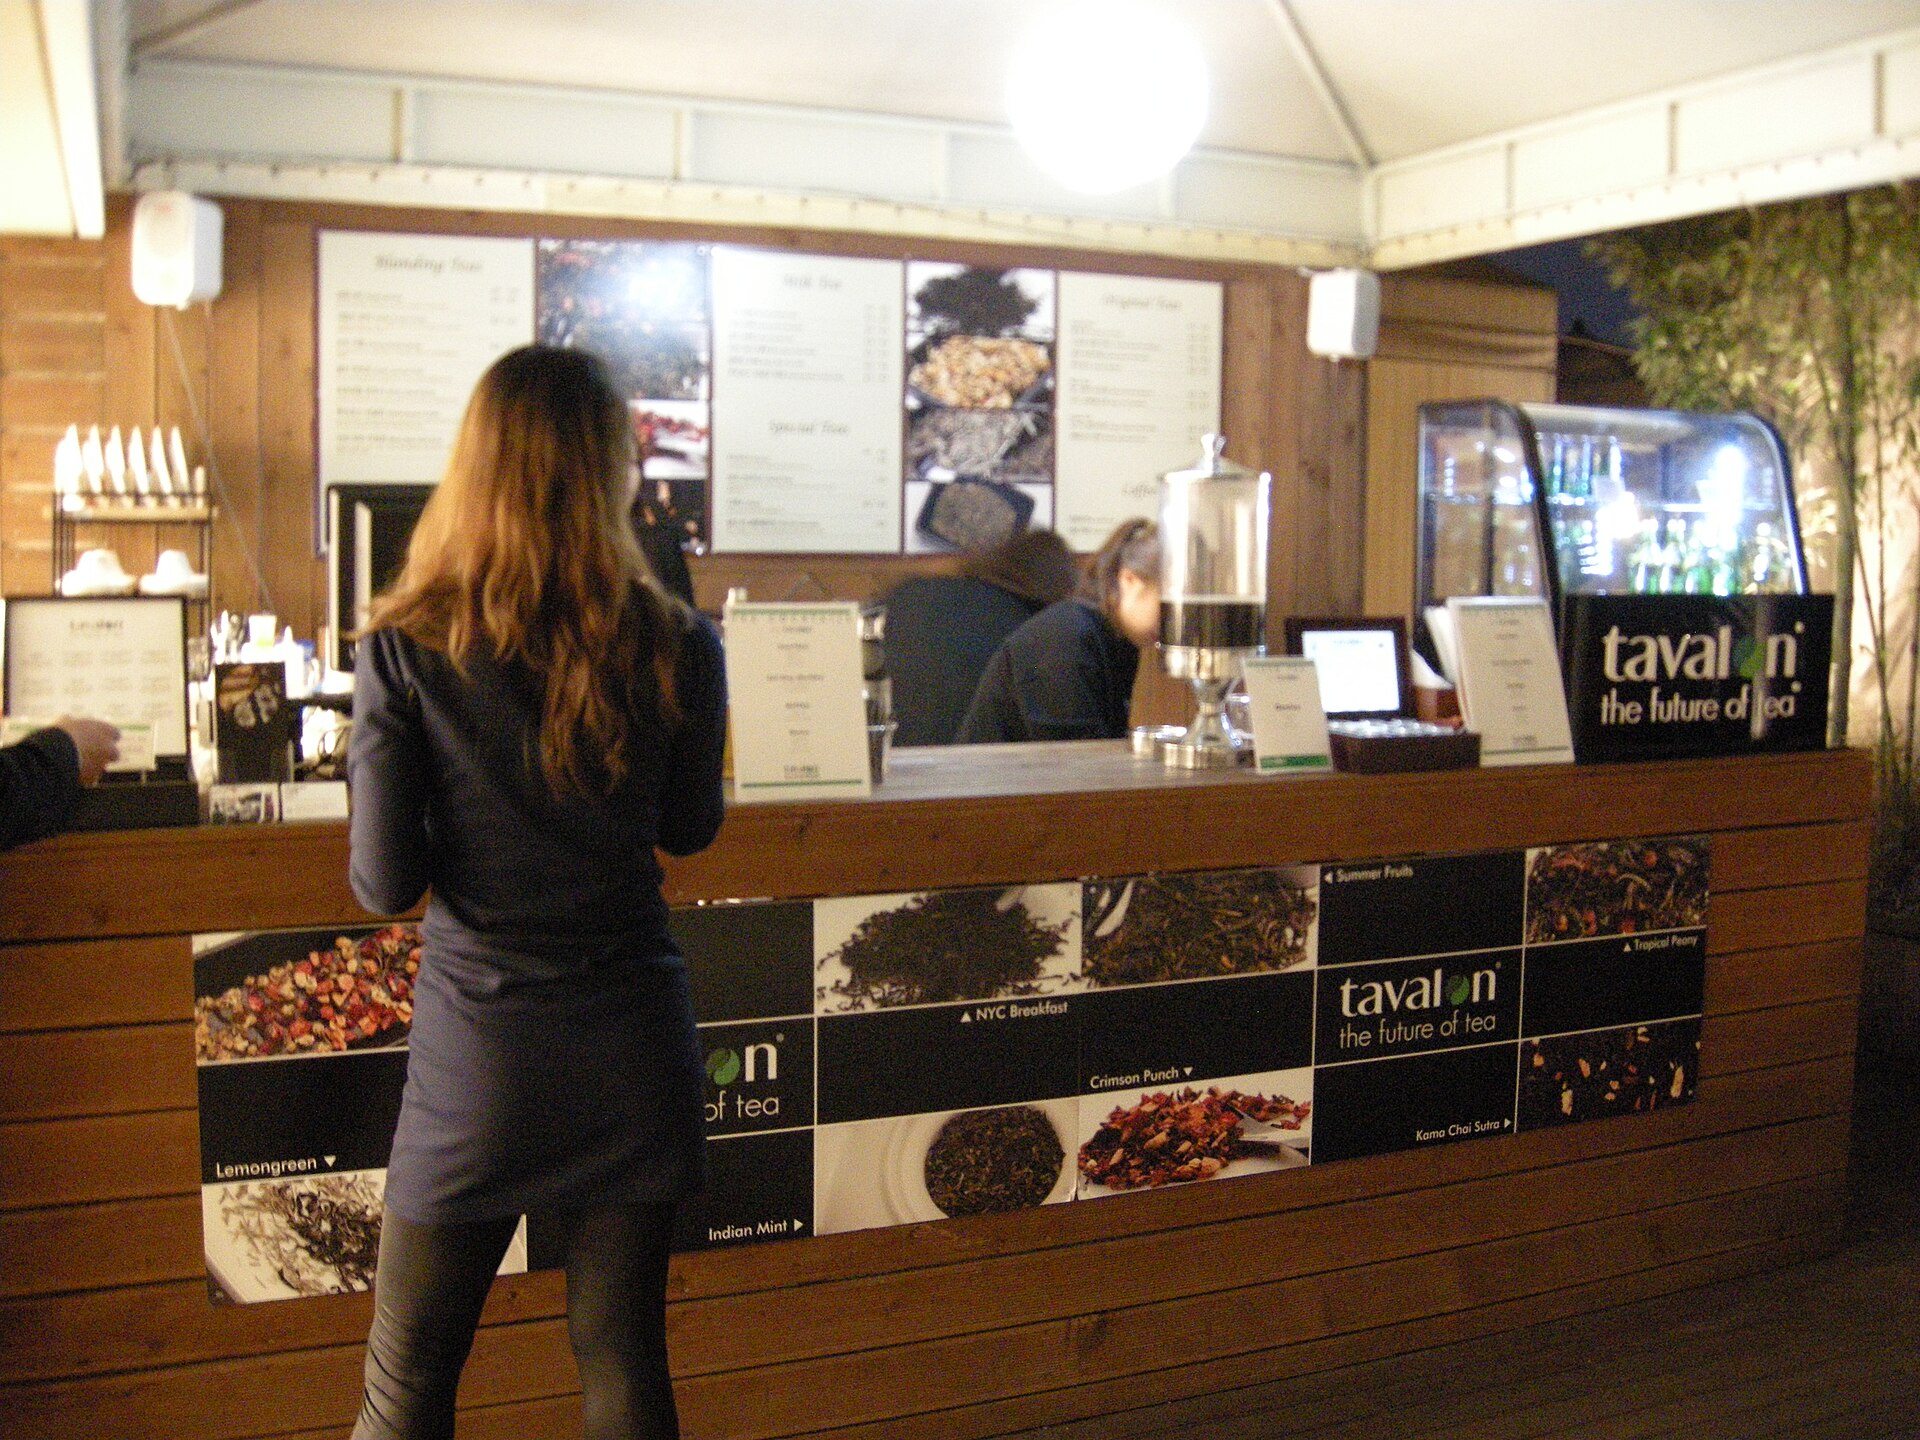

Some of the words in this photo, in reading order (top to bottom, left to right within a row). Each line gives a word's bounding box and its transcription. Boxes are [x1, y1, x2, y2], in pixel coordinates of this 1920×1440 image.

[1602, 625, 1798, 682] tavalon
[1601, 687, 1643, 725] the
[1650, 686, 1720, 723] future
[1724, 684, 1750, 720] of
[1336, 868, 1382, 882] Summer
[1384, 864, 1414, 879] Fruits
[1634, 936, 1669, 952] Tropical
[1339, 968, 1497, 1017] tavalon
[976, 1005, 1006, 1020] NYC
[1010, 1000, 1068, 1018] Breakfast
[1340, 1023, 1372, 1049] the
[1379, 1018, 1434, 1044] future
[1439, 1009, 1460, 1037] of
[1465, 1012, 1496, 1034] tea
[1090, 1074, 1140, 1089] Crimson
[1143, 1066, 1179, 1082] Punch
[704, 1090, 727, 1122] of
[736, 1094, 779, 1118] tea
[1416, 1130, 1446, 1141] Kama
[1447, 1122, 1472, 1136] Chai
[1474, 1121, 1500, 1133] Sutra
[216, 1156, 318, 1178] Lemongreen
[708, 1224, 753, 1241] Indian
[756, 1220, 788, 1235] Mint
